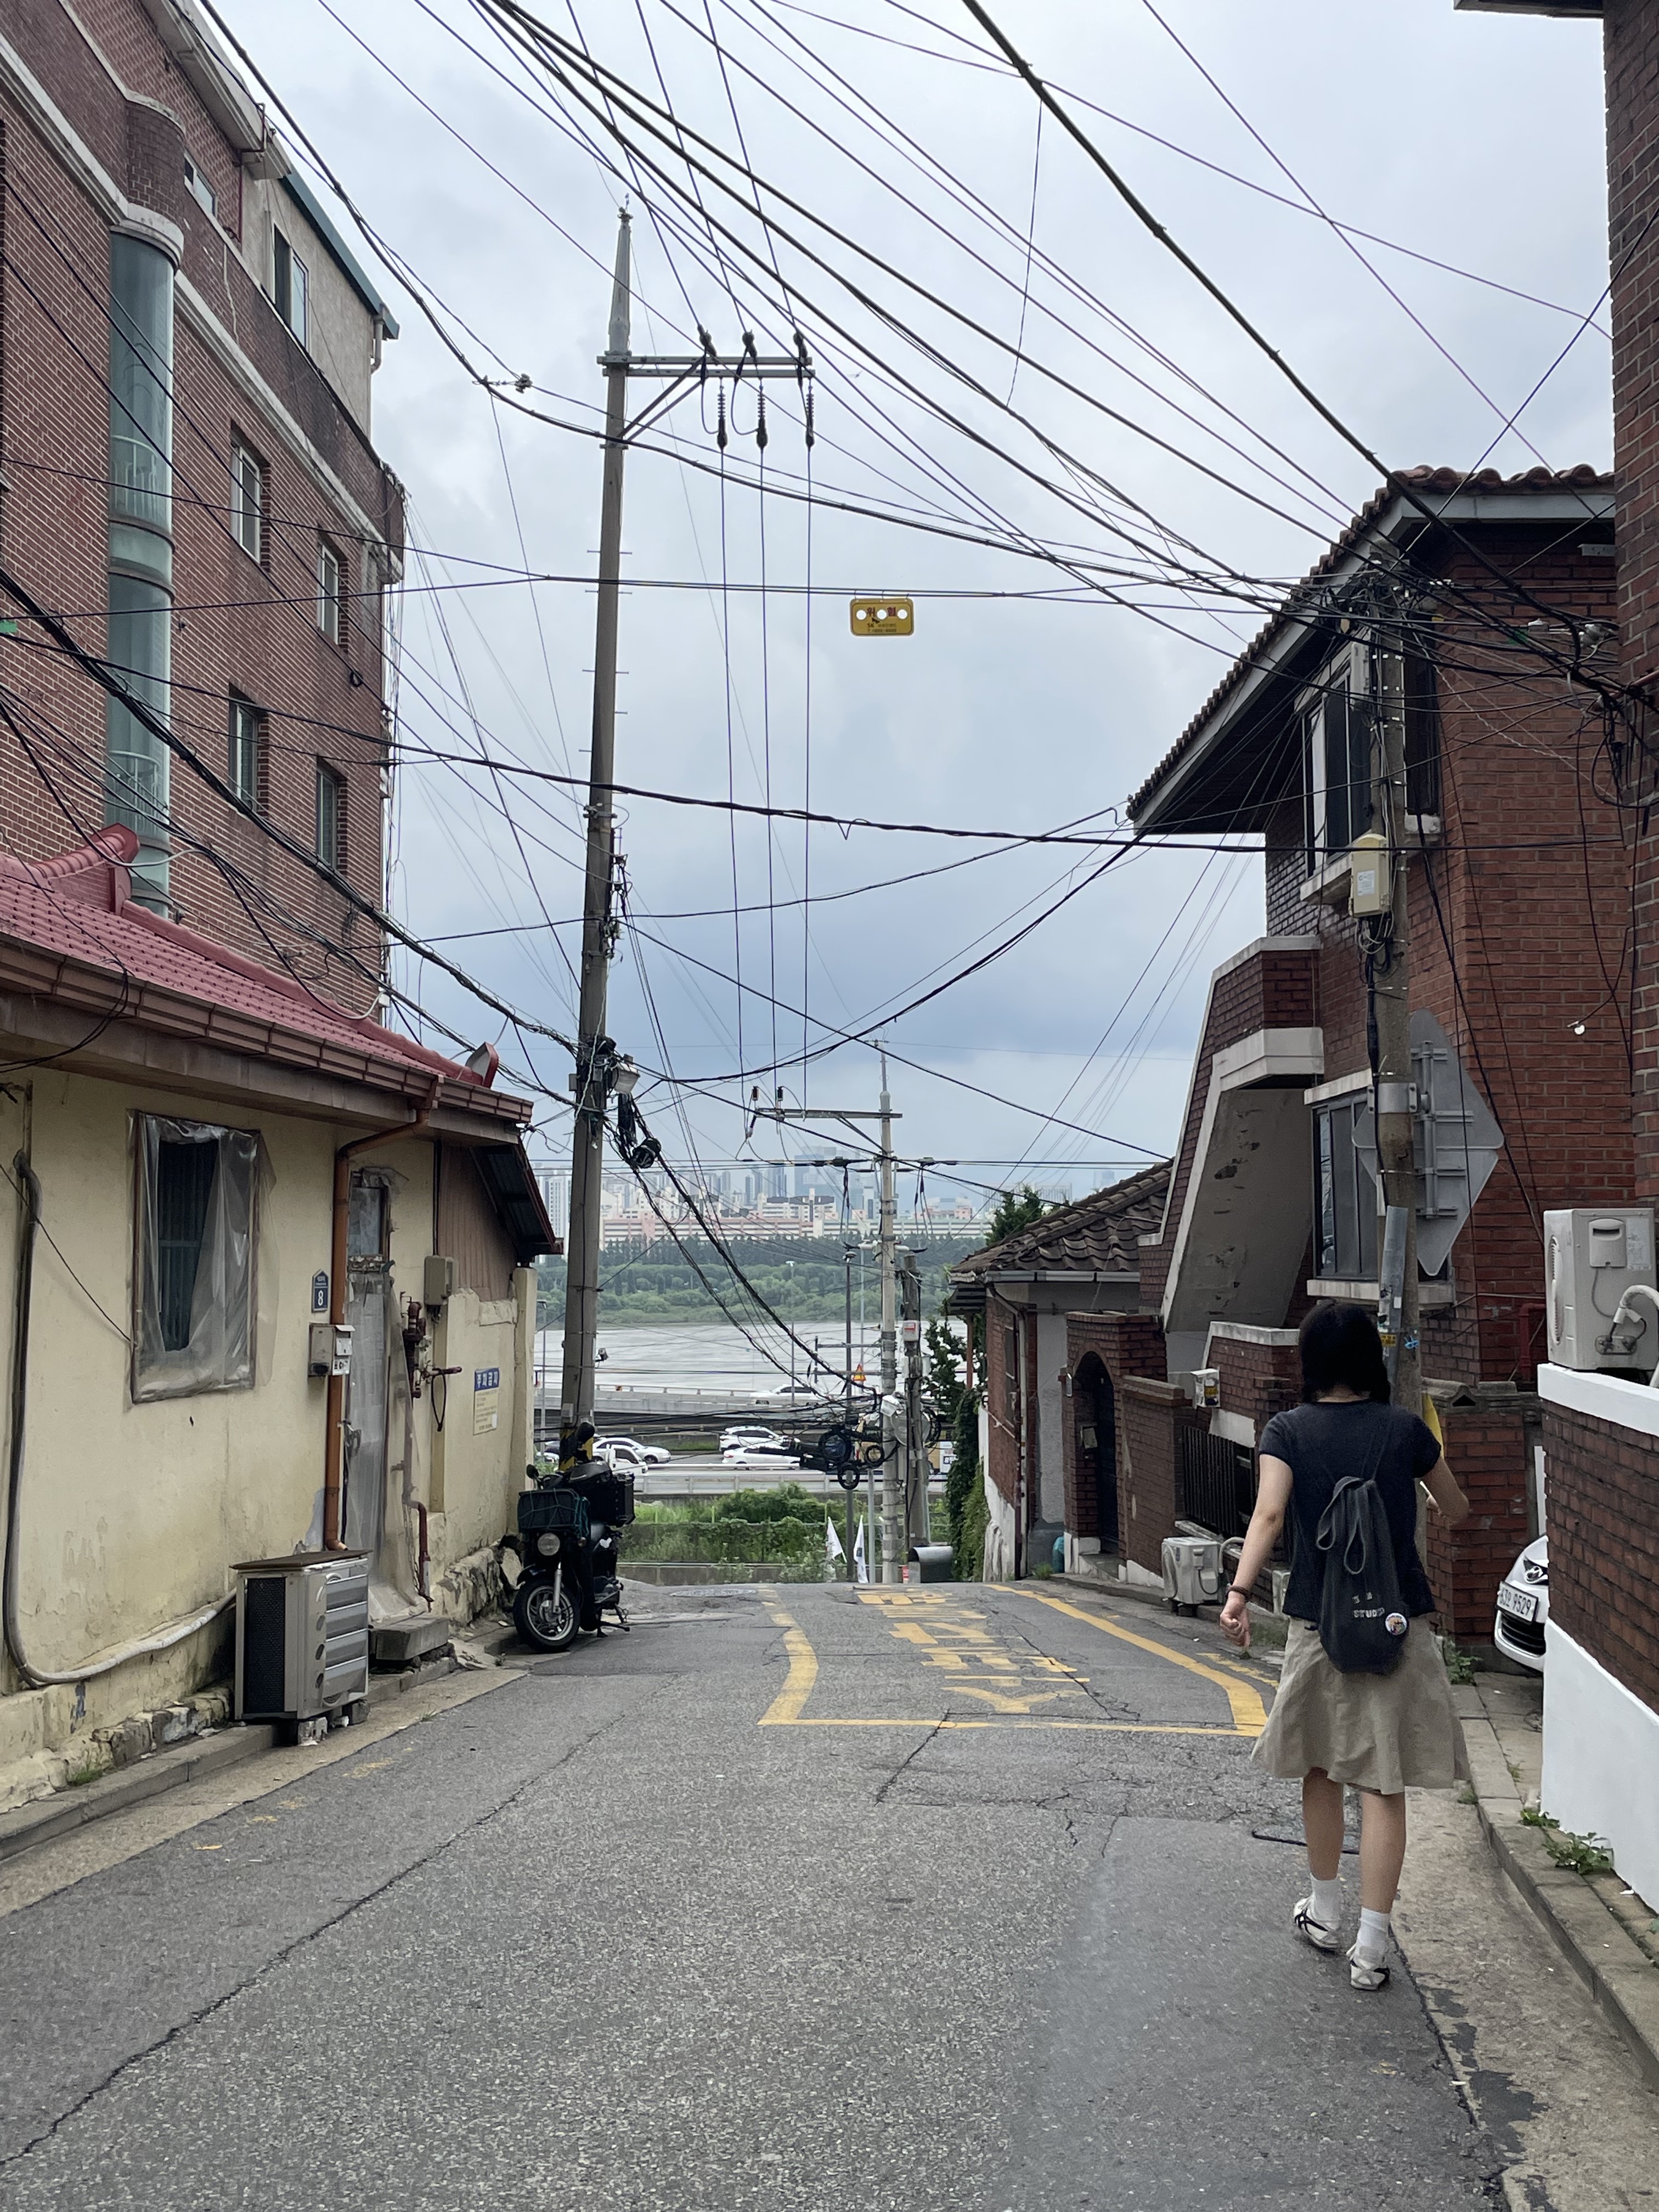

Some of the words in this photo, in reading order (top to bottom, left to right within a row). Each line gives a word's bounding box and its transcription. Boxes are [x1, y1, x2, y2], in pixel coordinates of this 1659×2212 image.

[867, 607, 896, 617] 위험
[318, 1290, 324, 1306] 8
[477, 1371, 498, 1389] 주차금지
[1512, 1593, 1532, 1616] 9529
